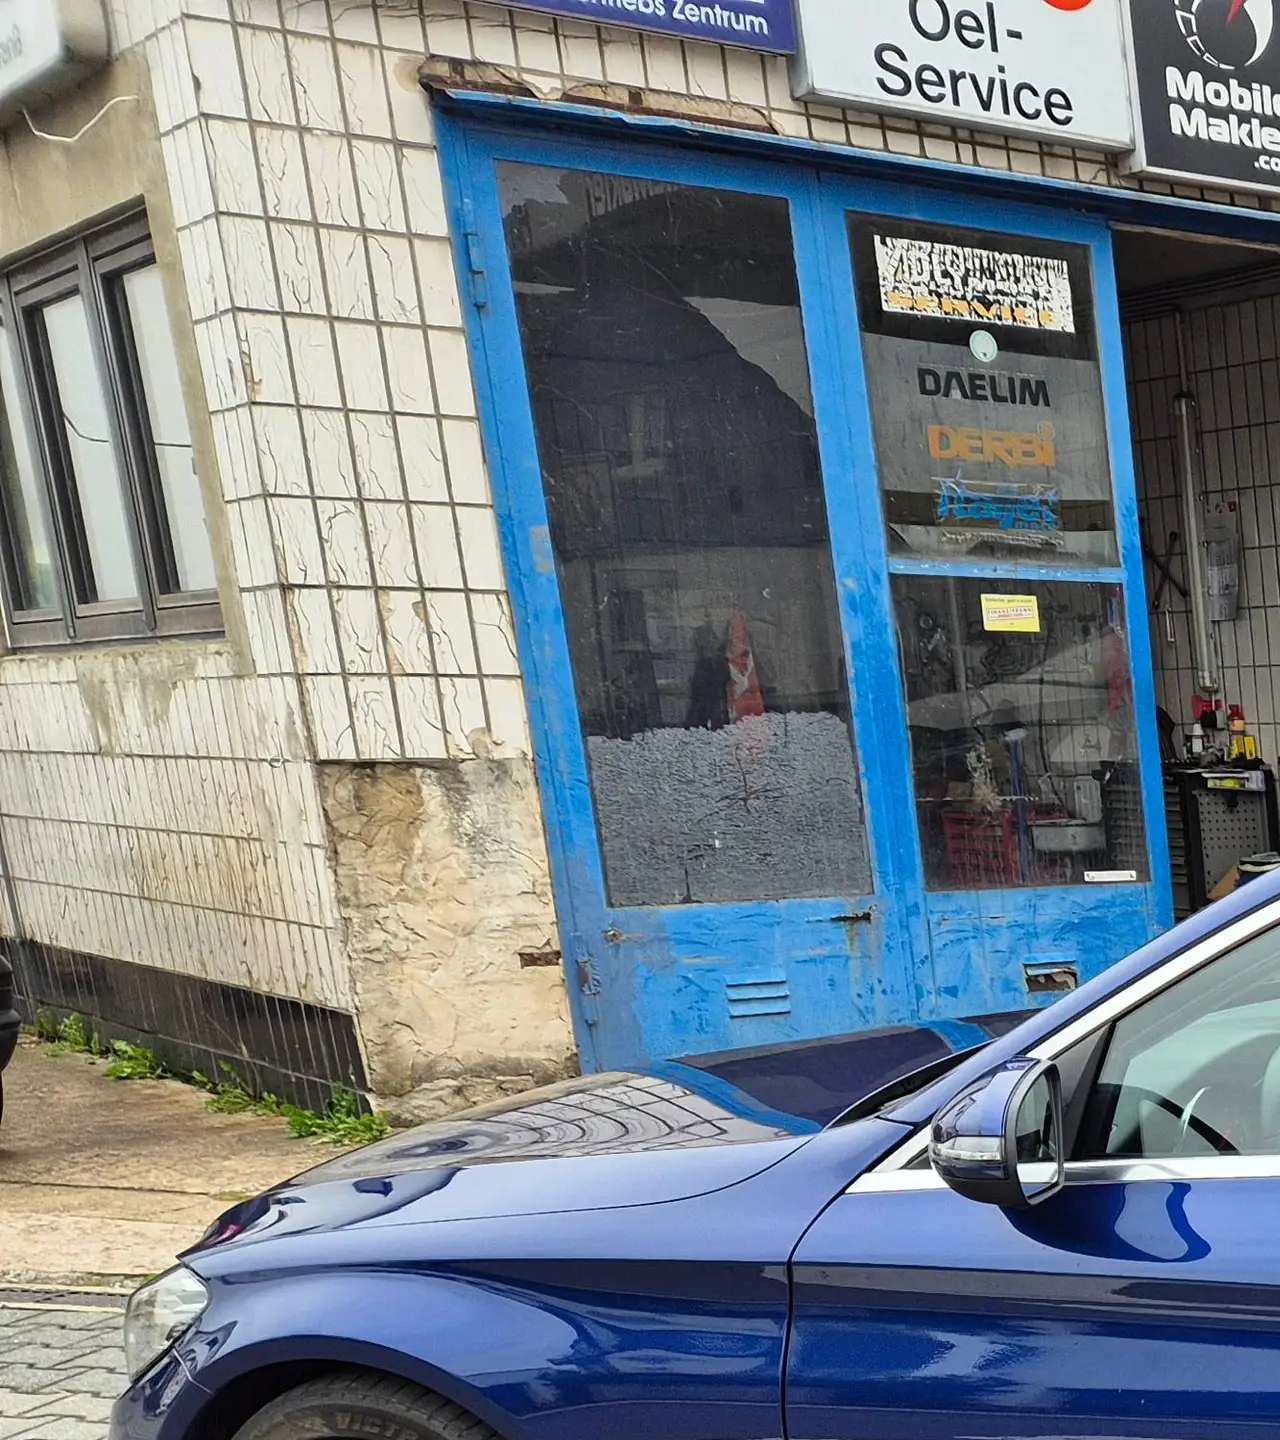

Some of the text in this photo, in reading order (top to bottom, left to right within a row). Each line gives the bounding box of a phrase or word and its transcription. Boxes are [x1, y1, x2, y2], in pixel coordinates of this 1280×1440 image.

[672, 0, 769, 35] Zentrum
[908, 0, 1023, 53] Oel-
[873, 42, 1074, 126] Service
[917, 367, 1051, 407] DAELIM
